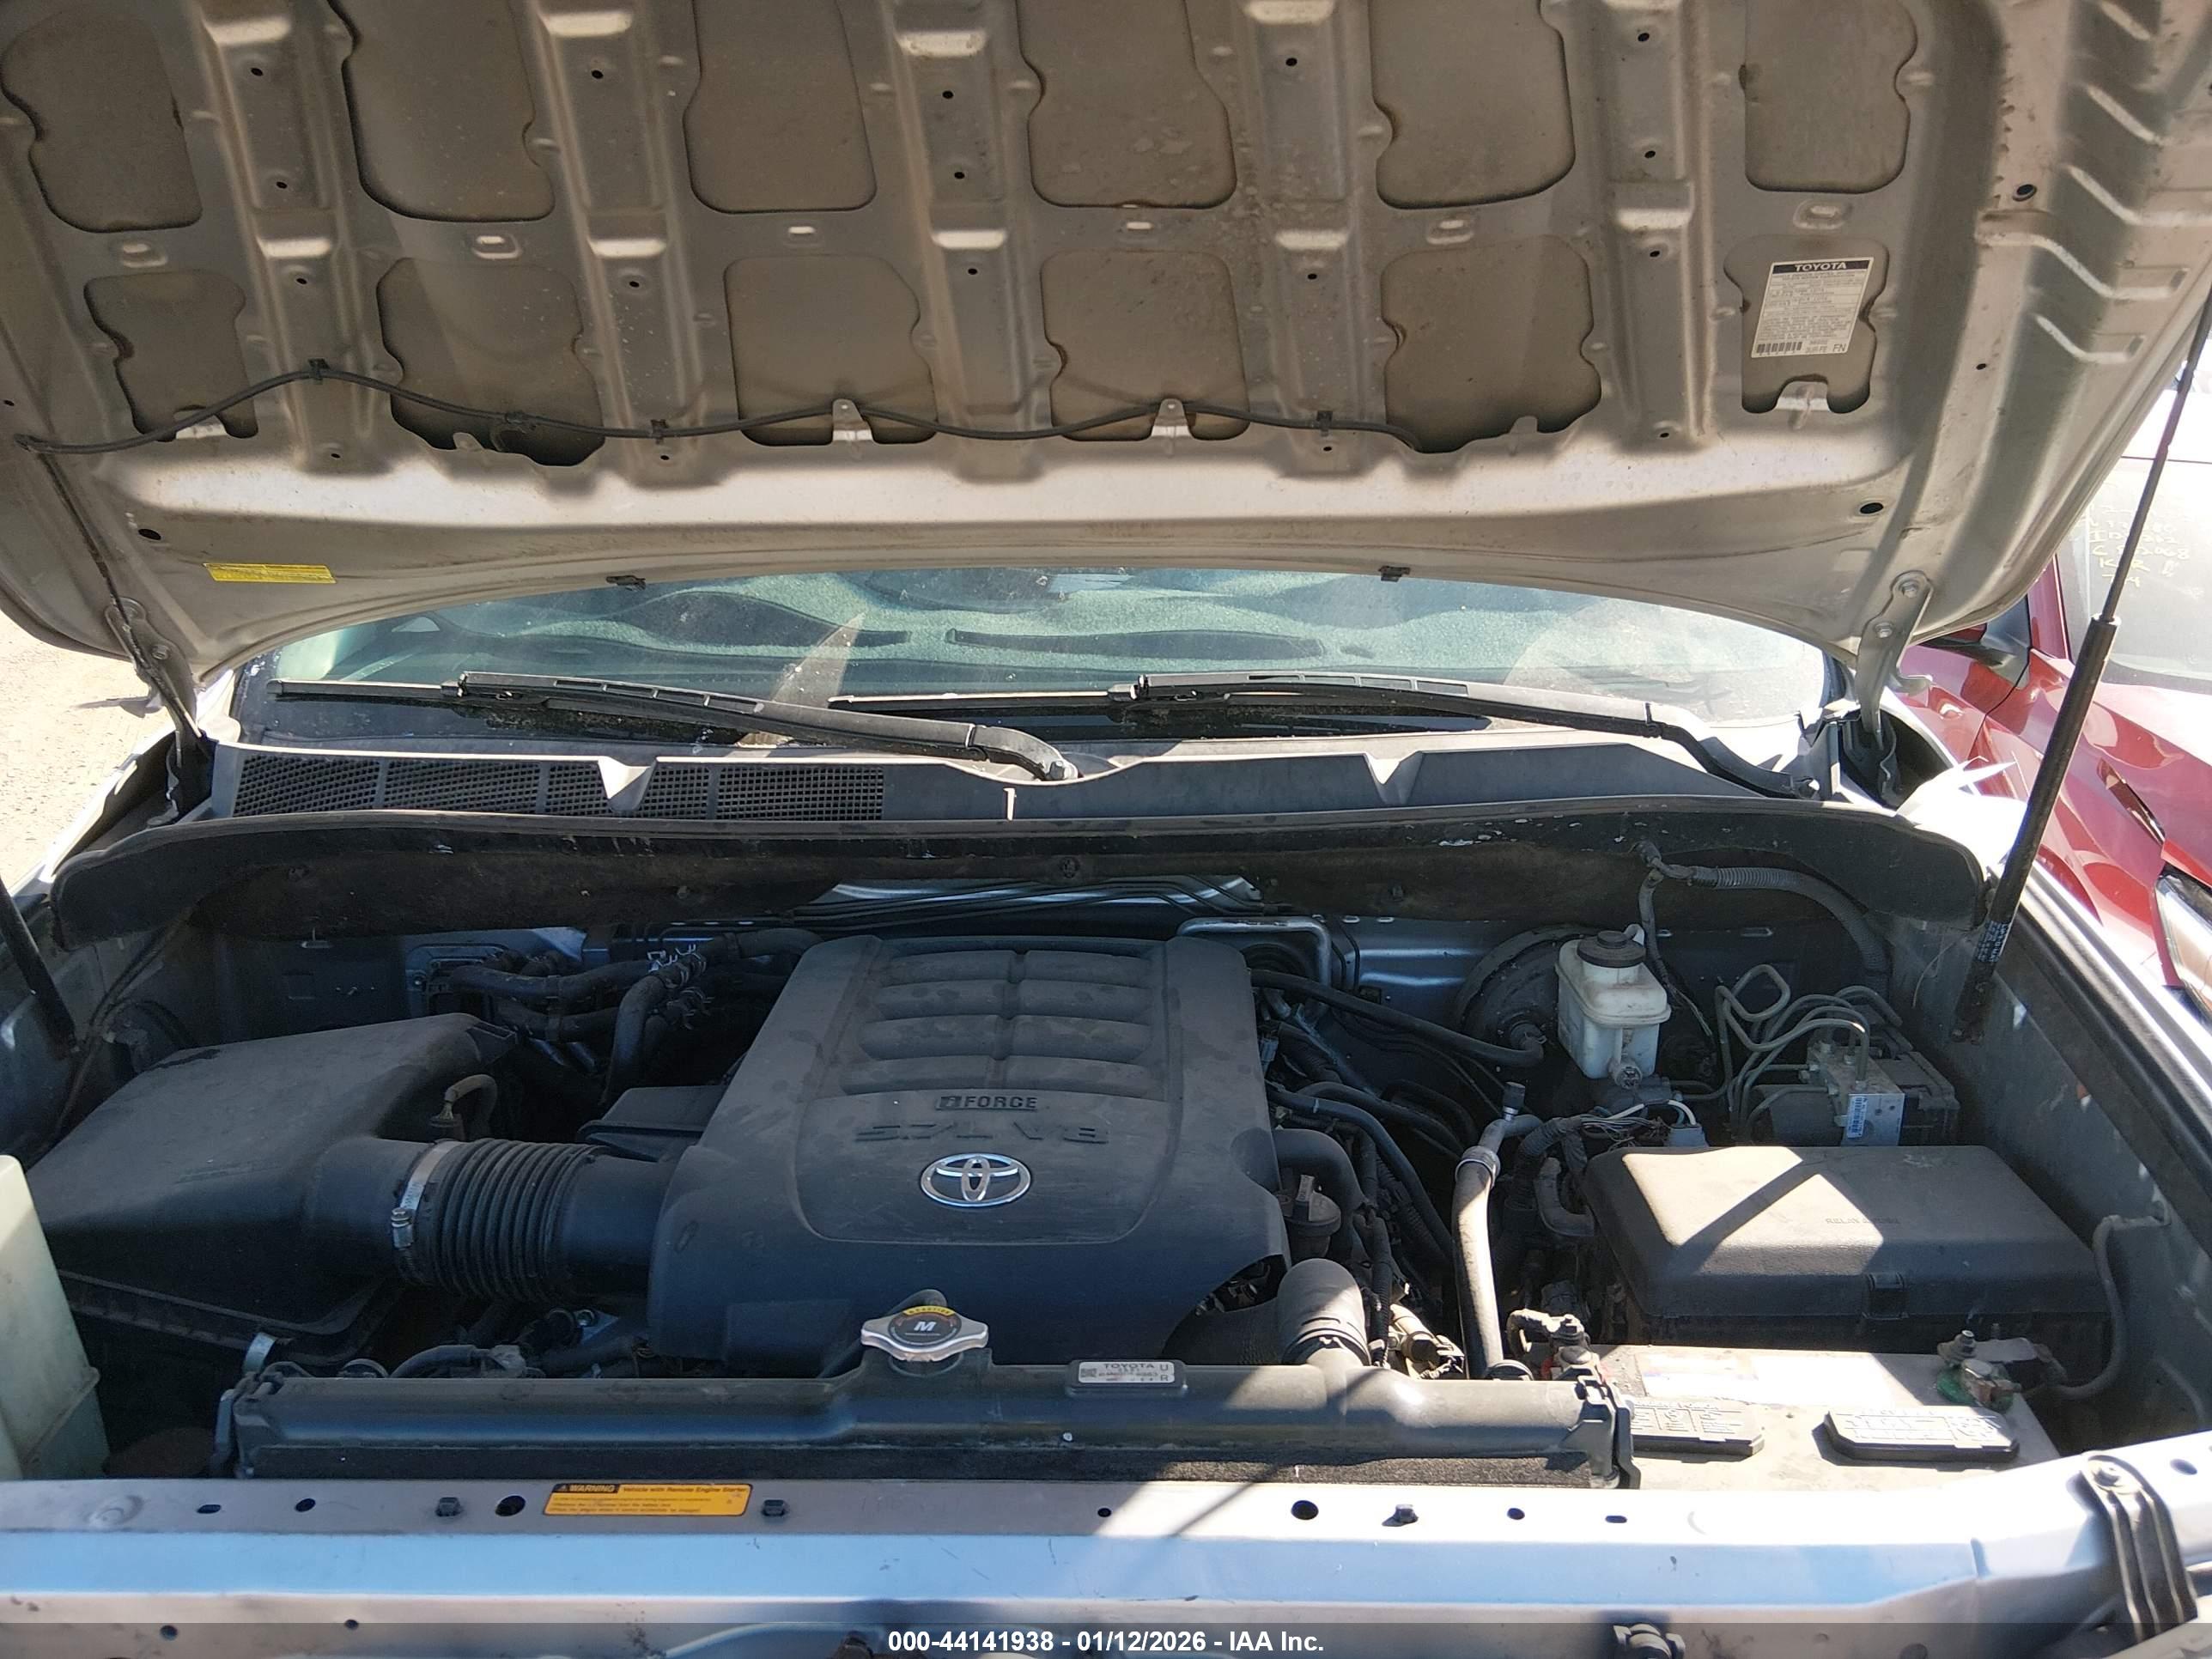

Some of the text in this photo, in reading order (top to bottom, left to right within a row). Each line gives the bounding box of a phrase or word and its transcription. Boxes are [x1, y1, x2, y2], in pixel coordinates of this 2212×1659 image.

[1794, 261, 1847, 272] TOYOTA
[1832, 343, 1846, 352] FN
[913, 1321, 937, 1332] M
[568, 1484, 617, 1493] WARNING
